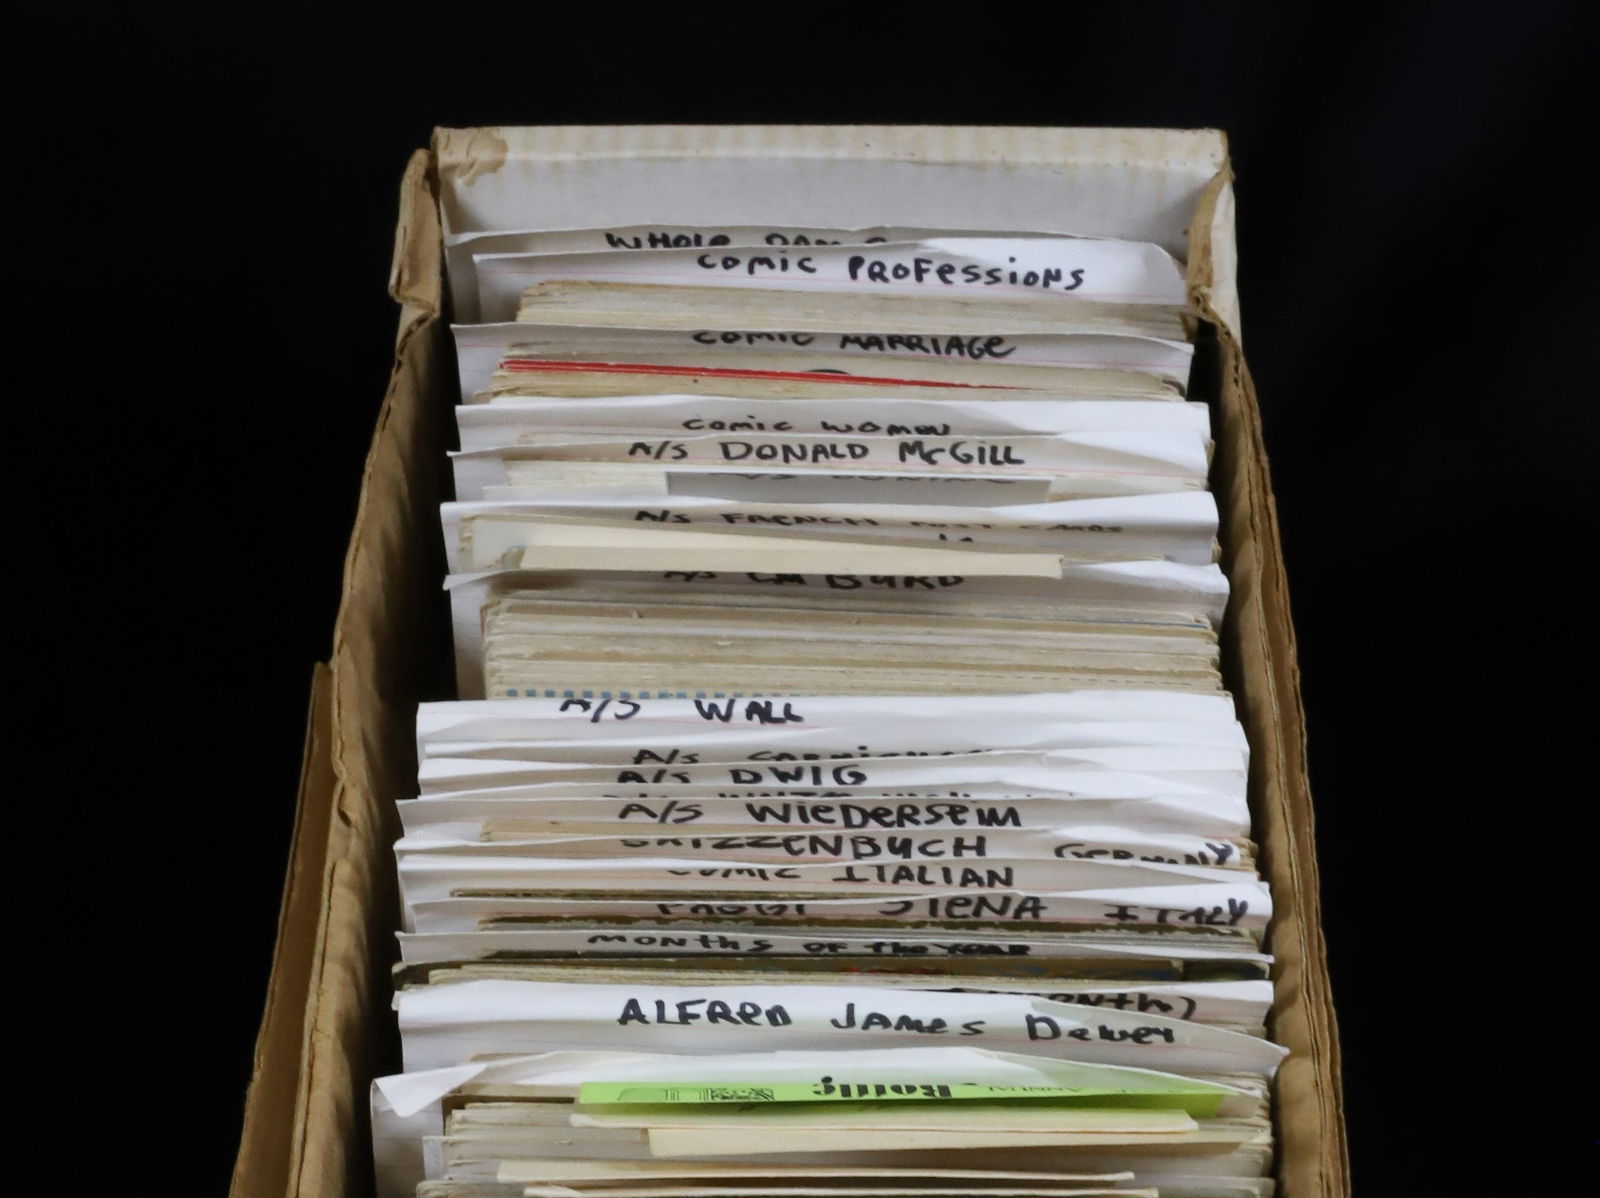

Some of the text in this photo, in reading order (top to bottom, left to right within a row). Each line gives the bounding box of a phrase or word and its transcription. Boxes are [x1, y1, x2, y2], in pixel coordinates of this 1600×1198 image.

[719, 441, 870, 464] DONALD
[694, 698, 805, 724] WALL
[729, 764, 868, 786] DWIG
[618, 801, 705, 824] A/S
